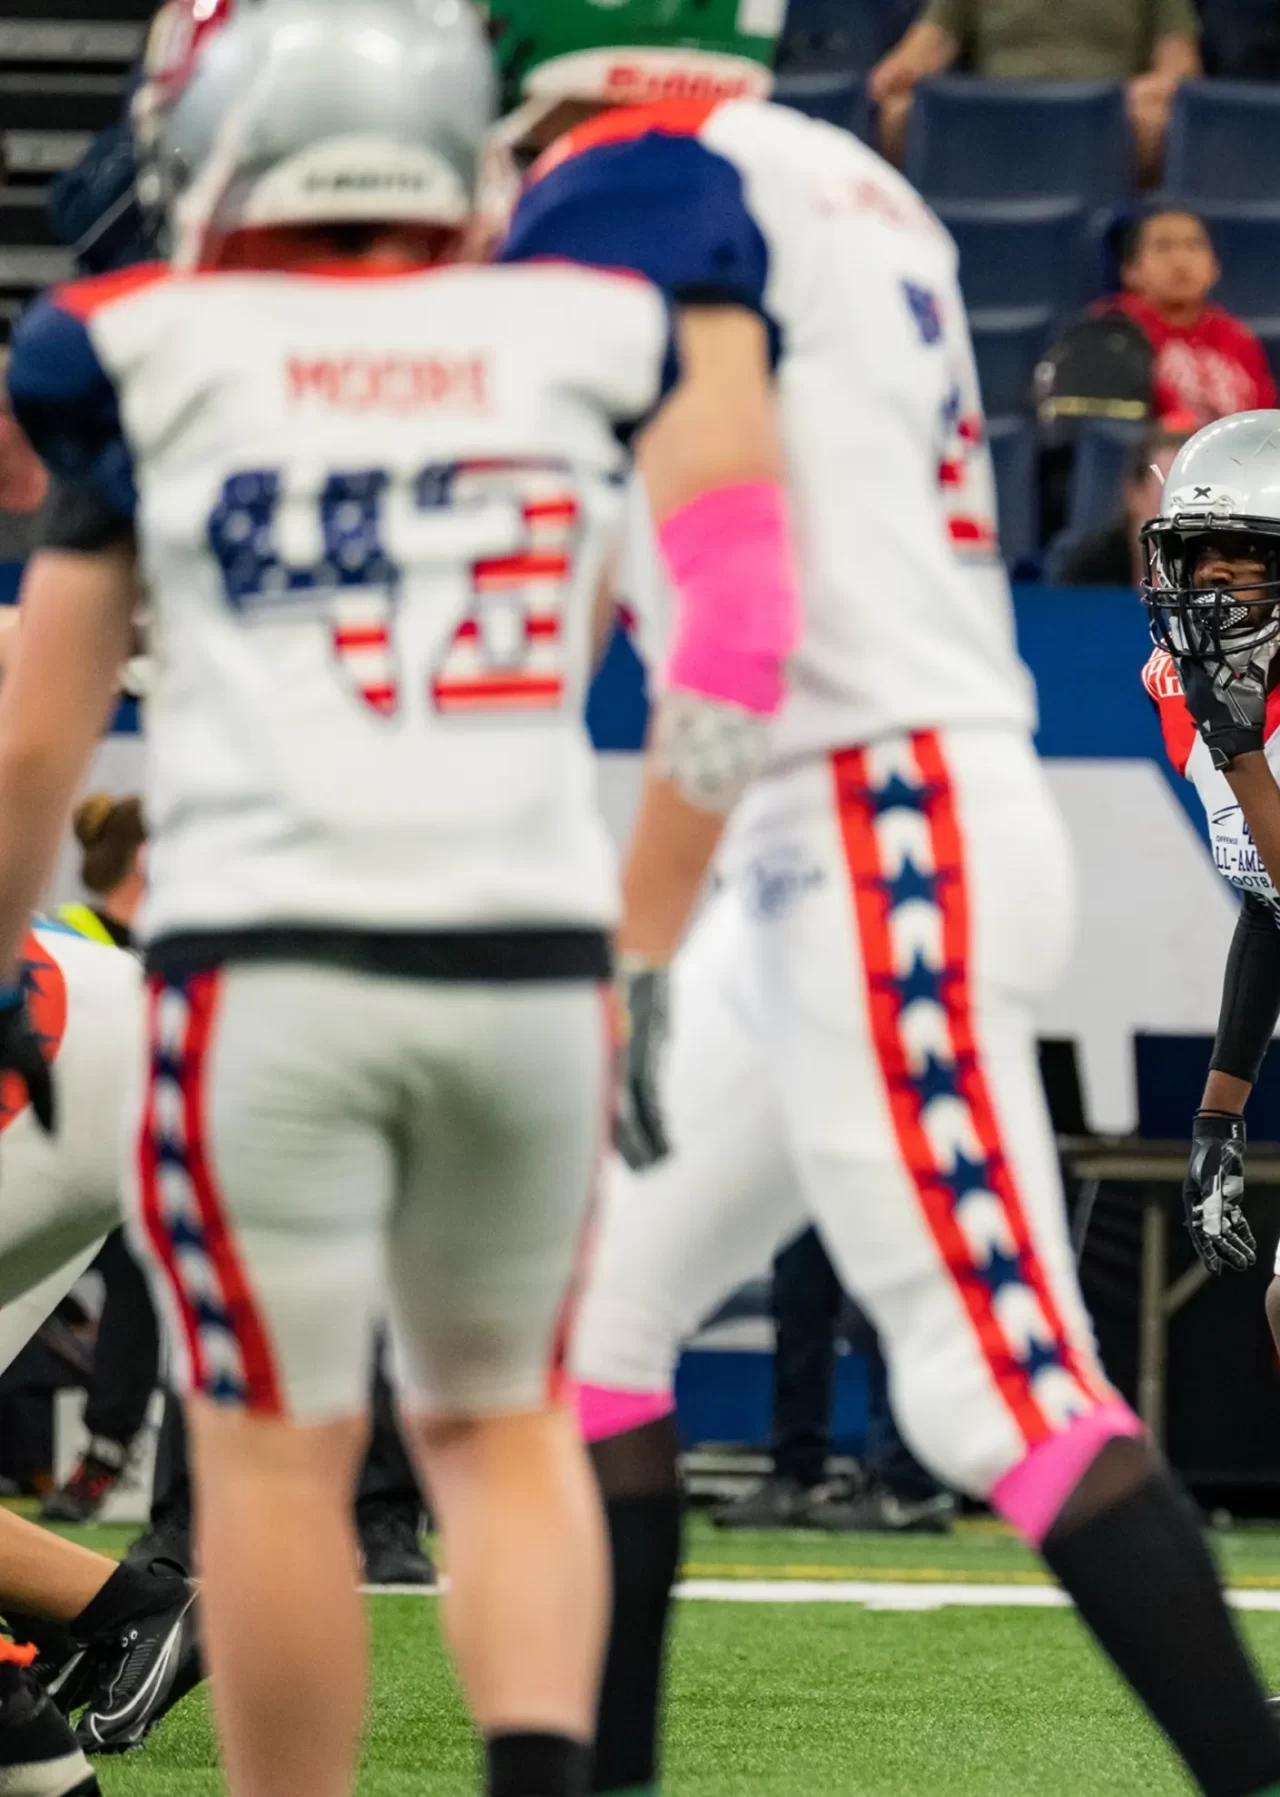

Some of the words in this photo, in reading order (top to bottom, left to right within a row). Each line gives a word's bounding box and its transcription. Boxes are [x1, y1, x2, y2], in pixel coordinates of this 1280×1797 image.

[205, 455, 582, 722] 42
[1215, 845, 1267, 873] LL-AME
[1224, 874, 1275, 888] OOTB
